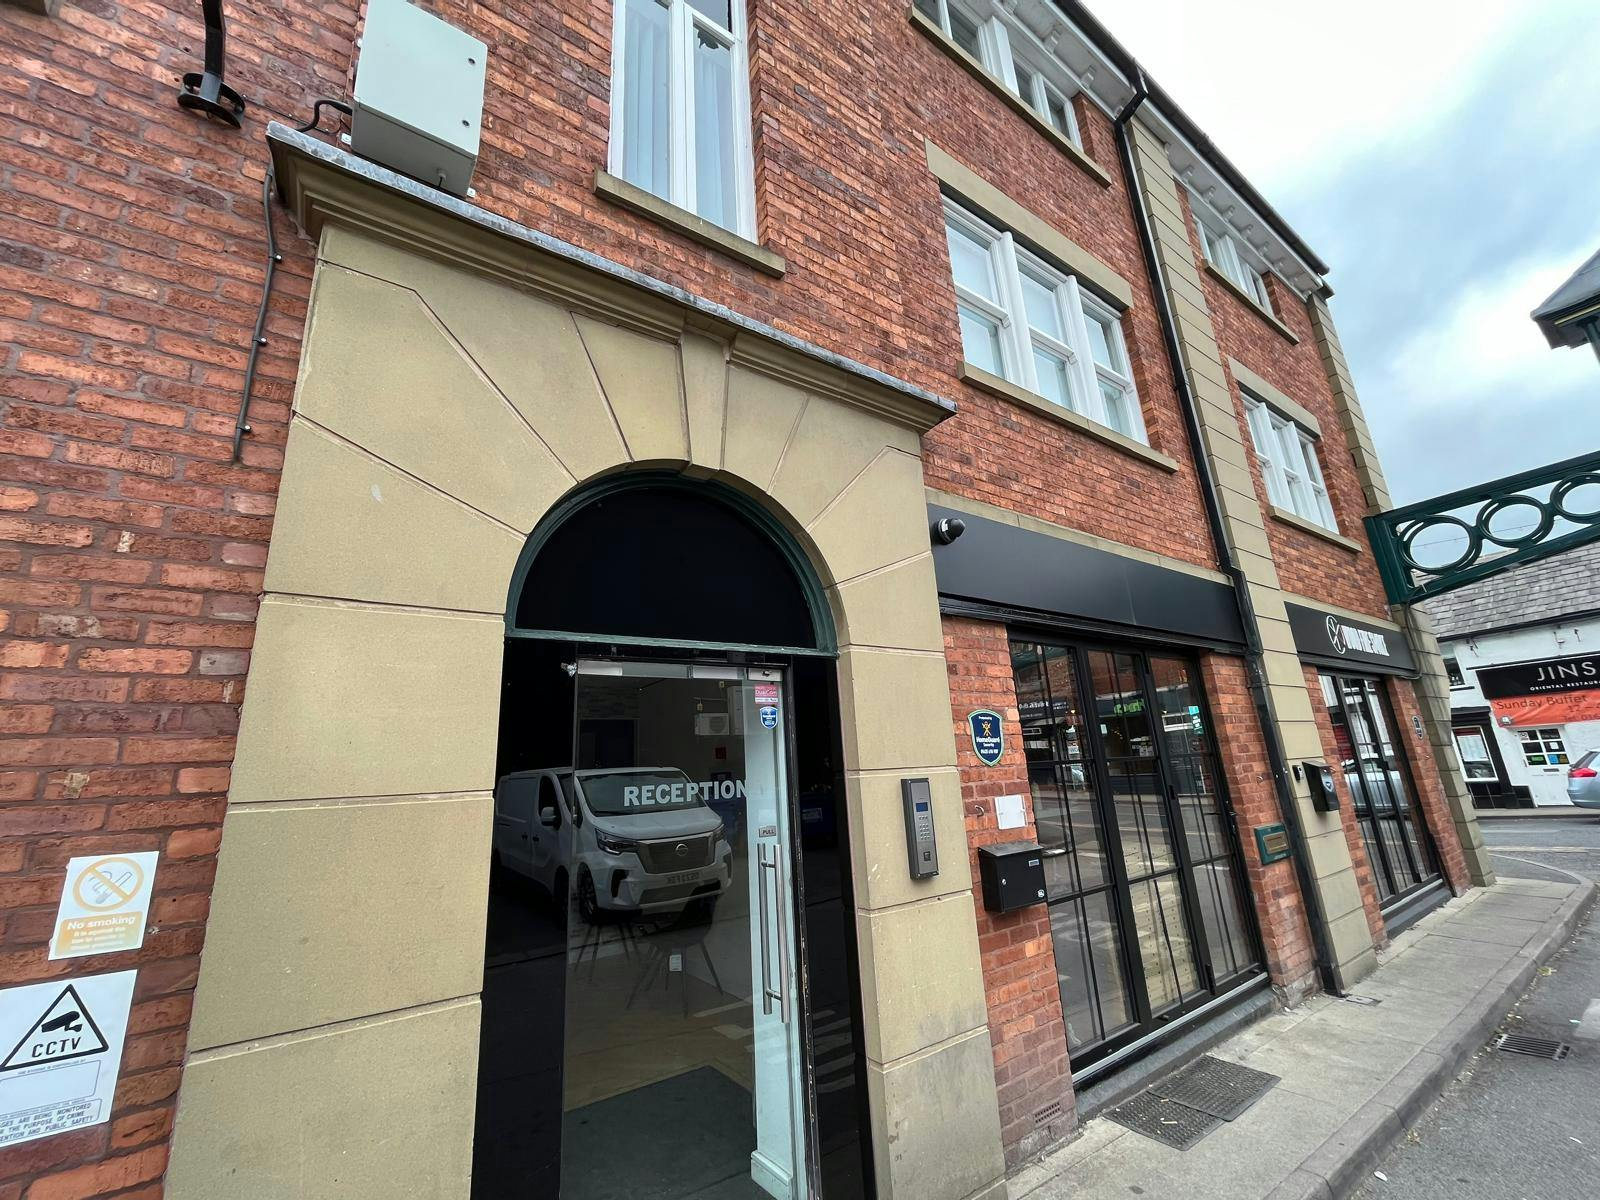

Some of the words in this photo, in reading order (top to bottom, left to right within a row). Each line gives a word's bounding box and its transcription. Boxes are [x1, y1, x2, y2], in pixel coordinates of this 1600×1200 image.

[1537, 661, 1596, 681] JINS
[1530, 683, 1564, 691] ORIENTAL
[1566, 680, 1600, 688] RESTAUR
[1496, 698, 1542, 710] Sunday
[1546, 695, 1588, 706] Buffet
[623, 780, 749, 807] RECEPTION
[67, 919, 85, 930] No
[87, 916, 136, 928] smoking
[31, 1036, 81, 1058] CCTV
[0, 1119, 13, 1128] GES
[34, 1111, 53, 1121] BEING
[57, 1103, 92, 1115] MONITORED
[24, 1118, 53, 1130] PURPOSE
[67, 1110, 85, 1120] CRIME
[0, 1130, 25, 1141] ENTION
[28, 1128, 40, 1136] AND
[45, 1121, 68, 1132] PUBLIC
[72, 1115, 94, 1125] SAFETY
